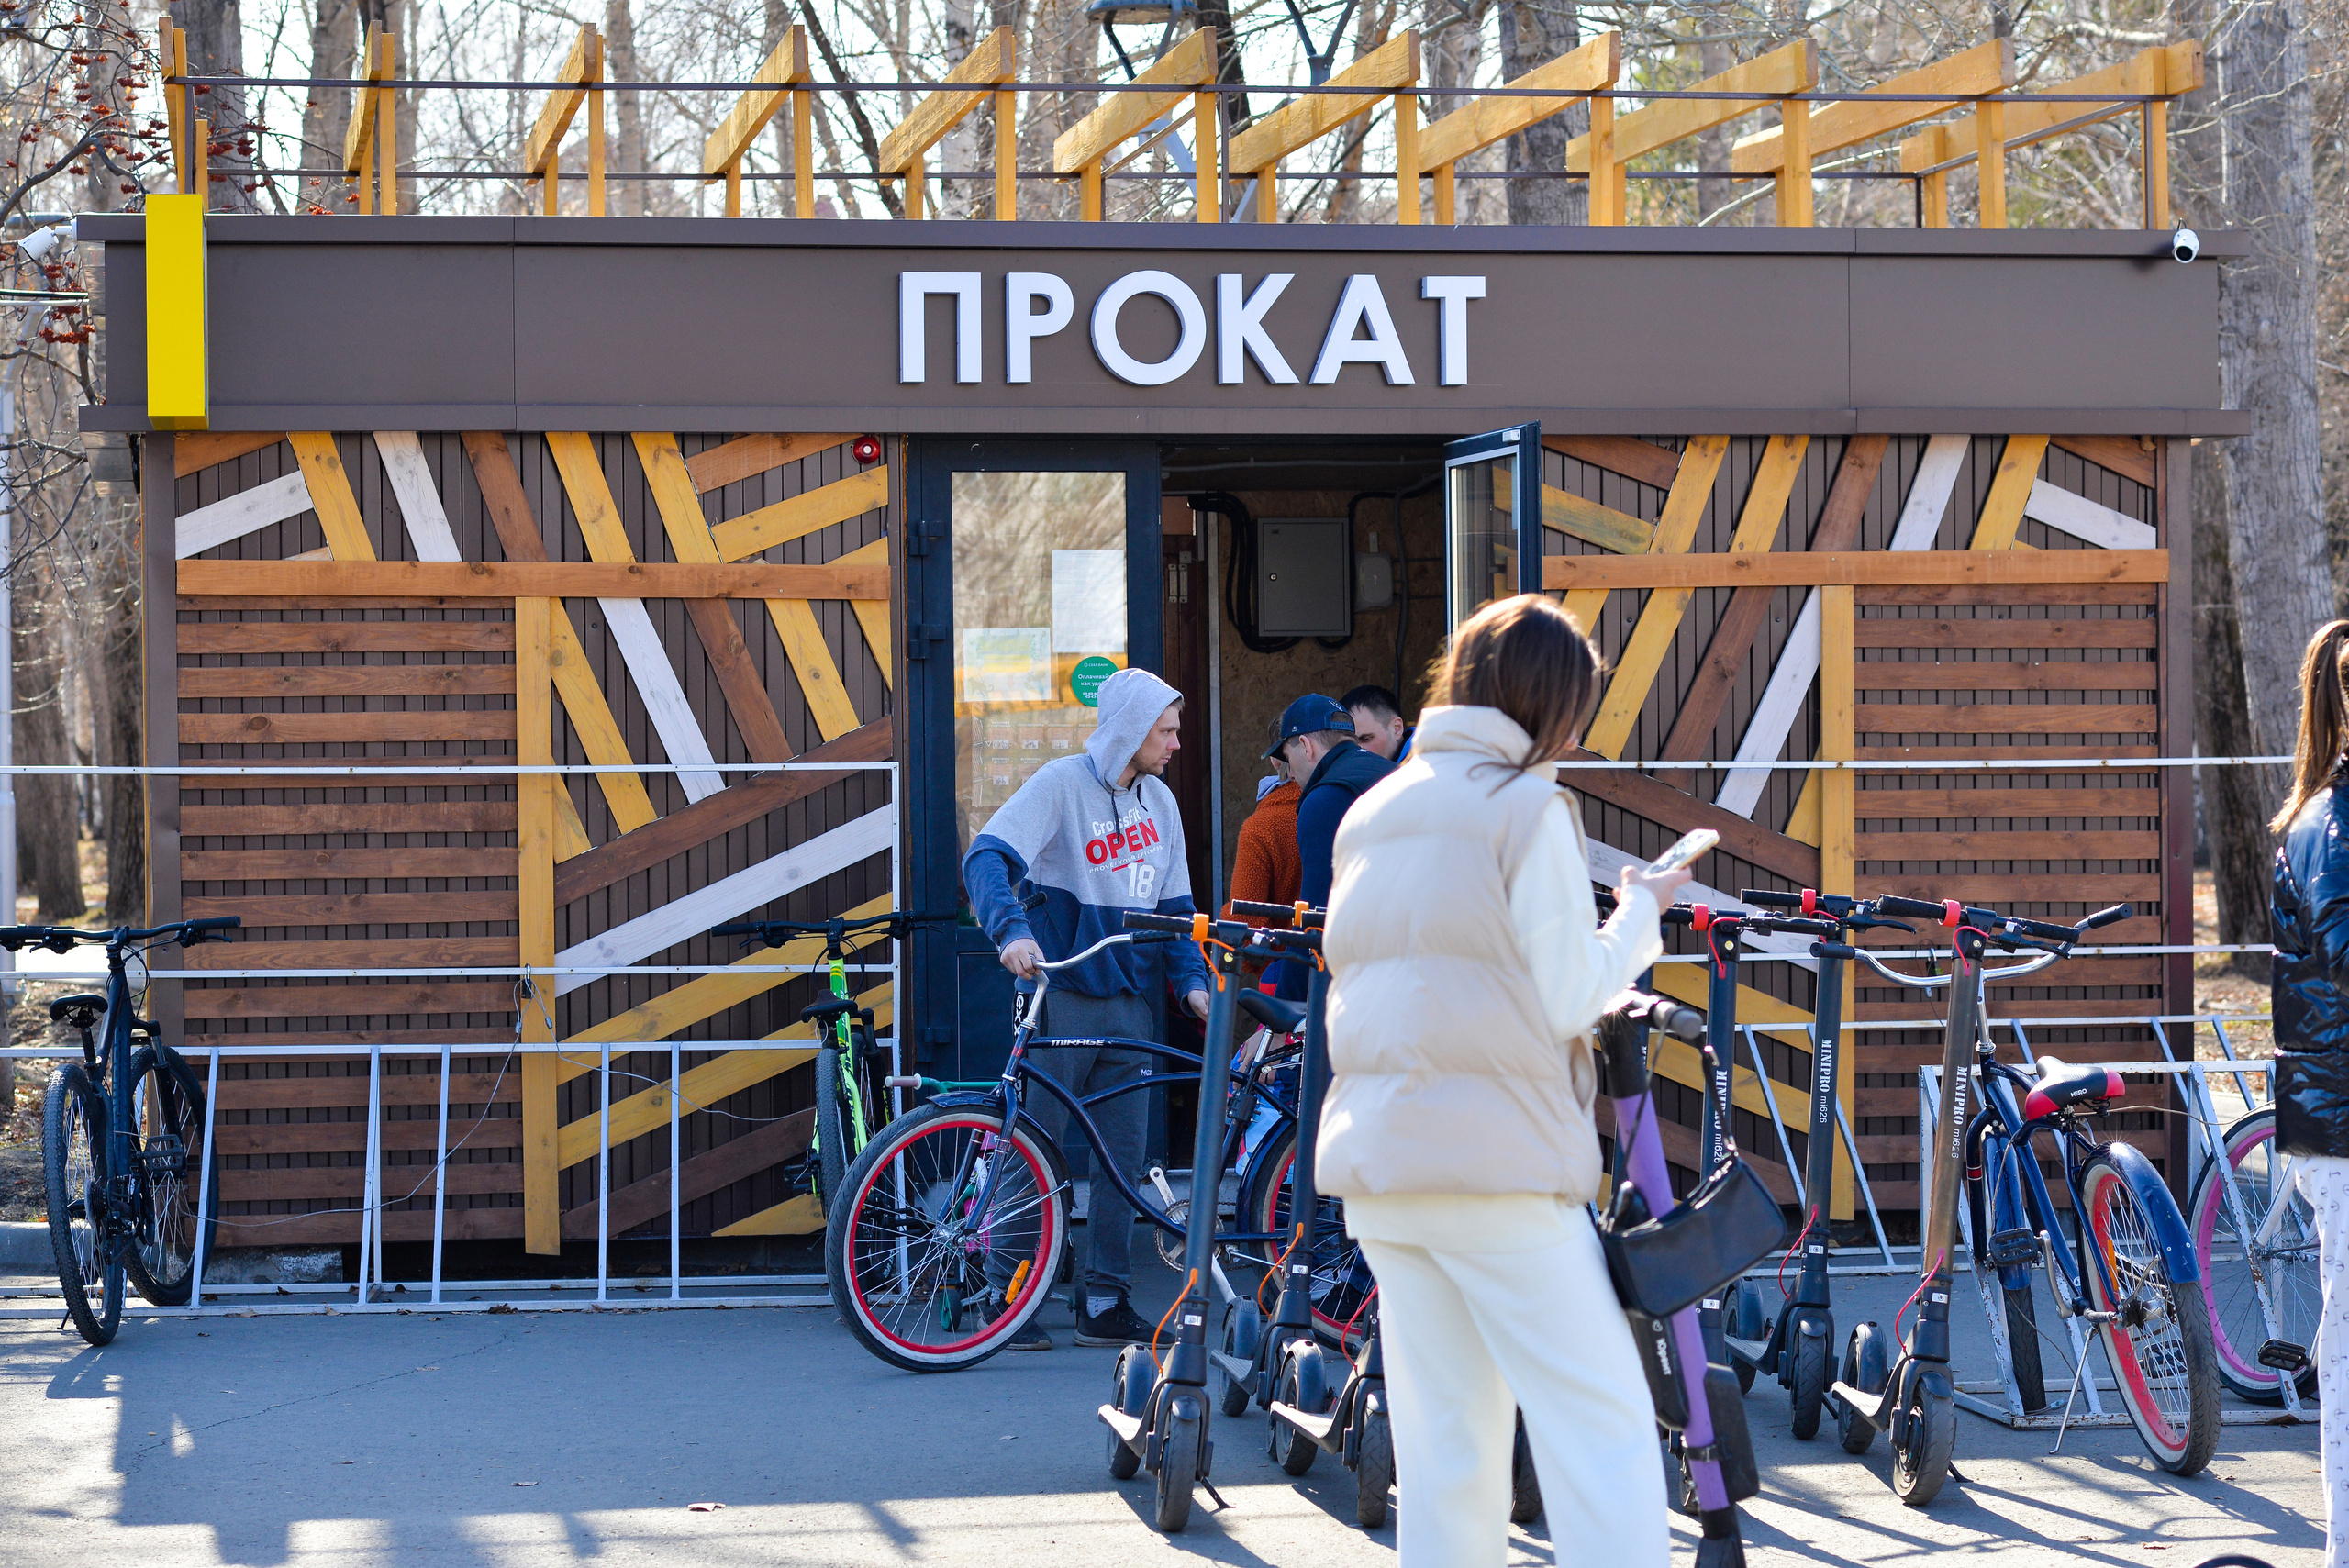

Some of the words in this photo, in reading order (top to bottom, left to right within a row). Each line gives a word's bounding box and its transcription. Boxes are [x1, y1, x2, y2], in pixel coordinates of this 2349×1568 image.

[899, 270, 1486, 386] ПРОКАТ
[1085, 818, 1160, 865] OPEN
[1128, 862, 1156, 899] 18
[1820, 1039, 1832, 1093] MINIPRO
[1820, 1095, 1829, 1124] mi626
[1953, 1065, 1968, 1125] MINIPRO
[2070, 1088, 2087, 1097] HERO
[1951, 1129, 1961, 1159] mi626
